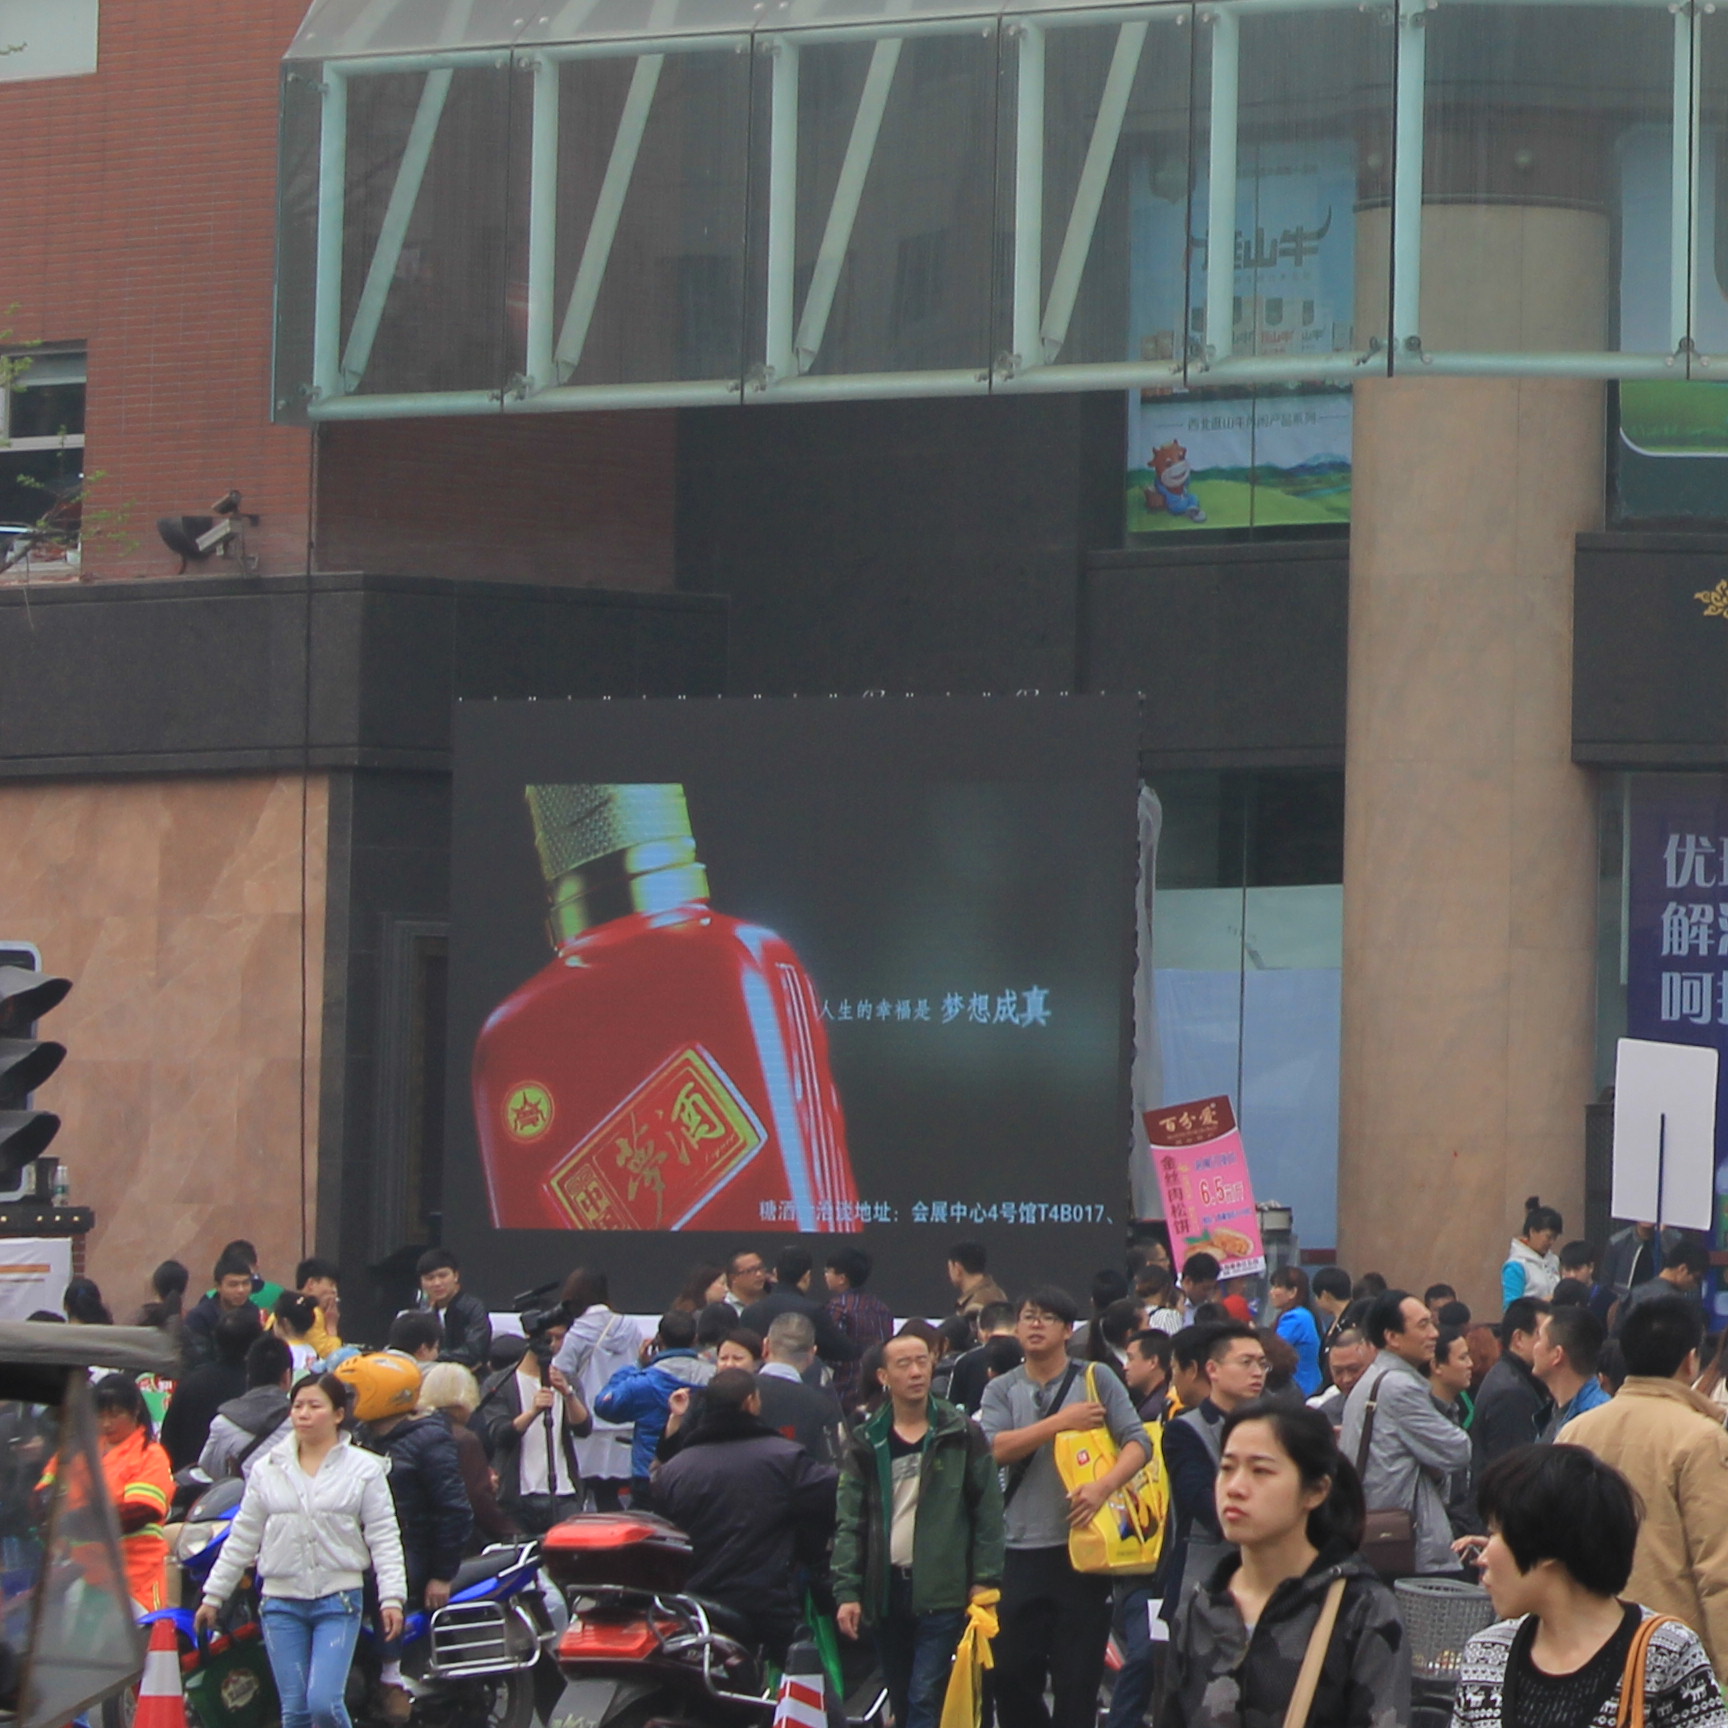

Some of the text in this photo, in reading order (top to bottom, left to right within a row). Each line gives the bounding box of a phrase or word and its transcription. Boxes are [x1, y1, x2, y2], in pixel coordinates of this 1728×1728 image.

[819, 985, 1052, 1027] 人生的幸福是 梦想成真
[759, 1199, 1114, 1225] 糖酒洽谈地址：会展中心4号馆T4B017、
